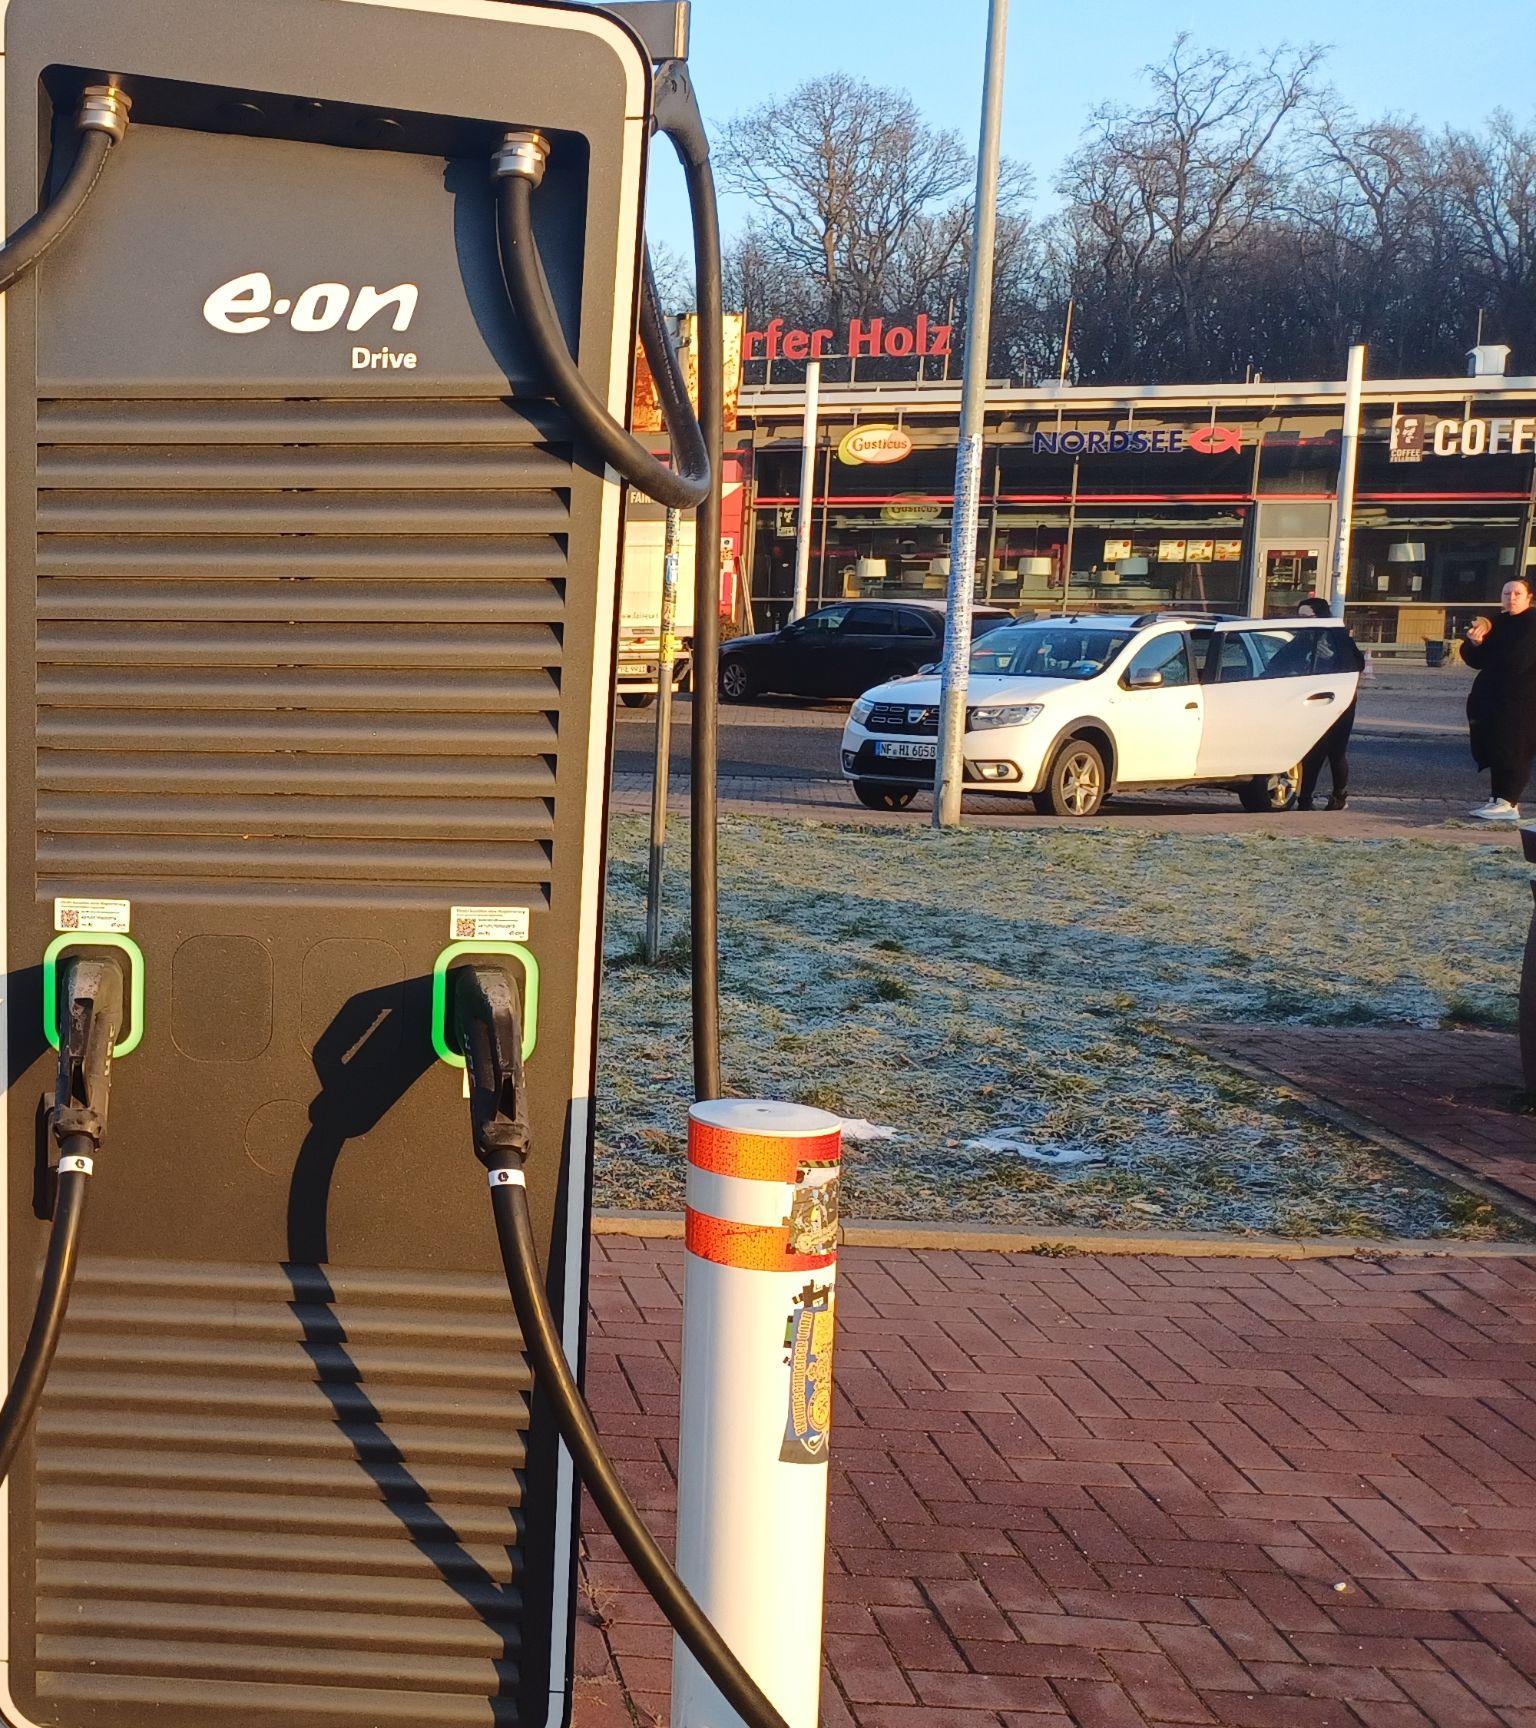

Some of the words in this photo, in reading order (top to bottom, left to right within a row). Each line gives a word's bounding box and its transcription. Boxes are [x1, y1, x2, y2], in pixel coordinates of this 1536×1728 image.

[743, 318, 834, 361] rfer
[847, 313, 952, 358] Holz
[351, 346, 417, 369] Drive
[851, 437, 908, 452] Gusticus
[1032, 429, 1184, 454] NORDSEE
[1433, 418, 1536, 456] COFF
